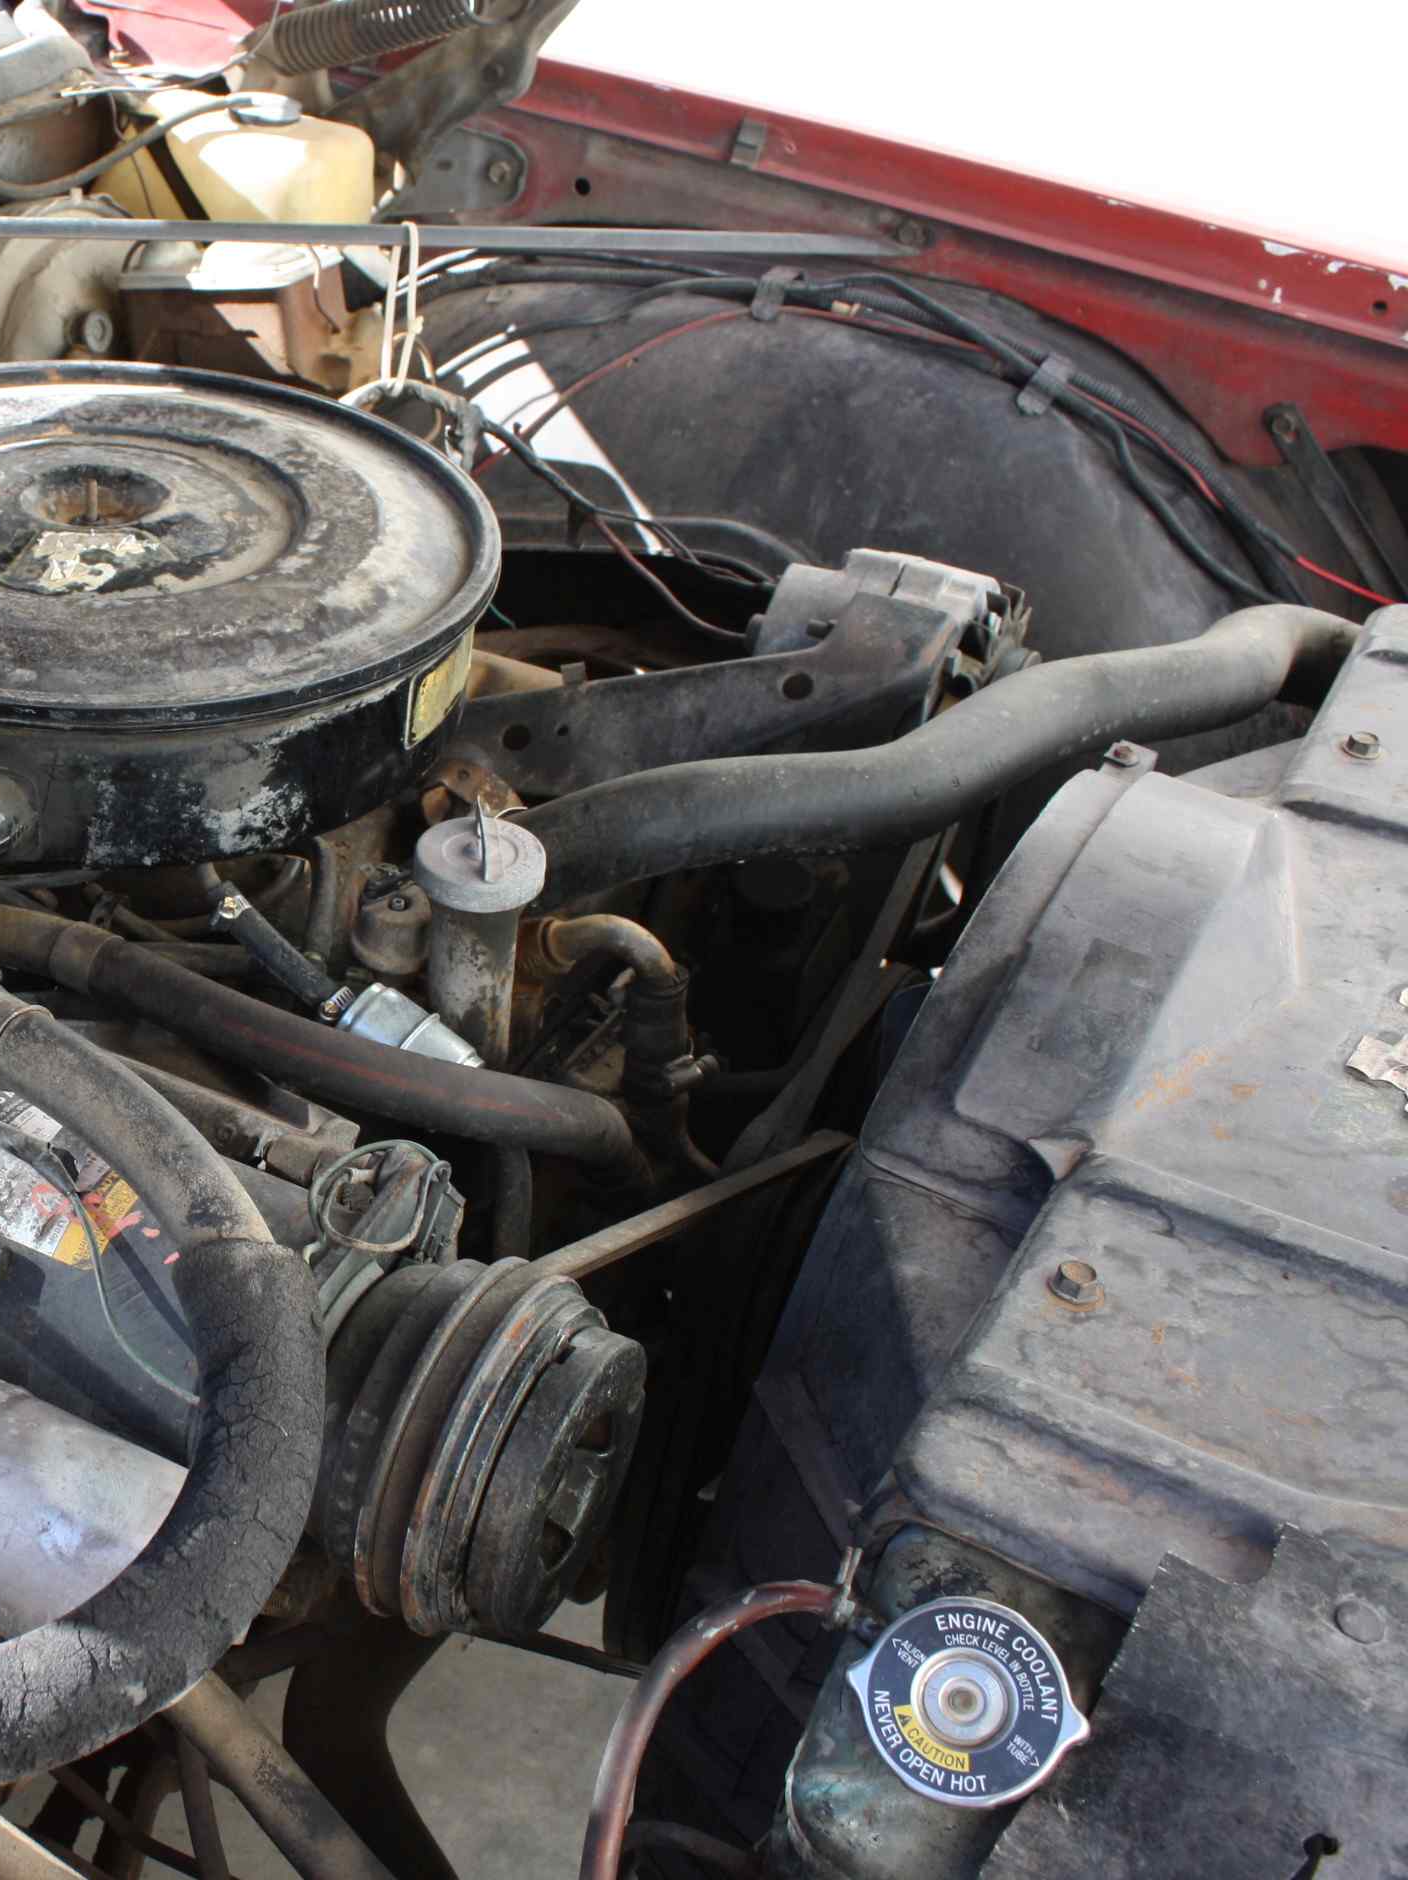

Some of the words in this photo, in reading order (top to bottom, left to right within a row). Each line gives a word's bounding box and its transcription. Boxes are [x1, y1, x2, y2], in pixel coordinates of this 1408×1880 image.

[897, 1647, 919, 1669] VENT
[900, 1640, 927, 1665] ALIGN
[935, 1613, 1010, 1641] ENGINE
[1011, 1636, 1058, 1725] COOLANT
[944, 1633, 986, 1646] CHECK
[982, 1640, 1010, 1665] LEVEL
[1009, 1661, 1022, 1673] IN
[1016, 1672, 1035, 1712] BOTTLE
[874, 1690, 903, 1748] NEVER
[899, 1748, 945, 1787] OPEN
[950, 1774, 988, 1793] HOT
[907, 1728, 966, 1770] CAUTION
[1005, 1742, 1030, 1766] TUBE
[1013, 1734, 1036, 1756] WITH
